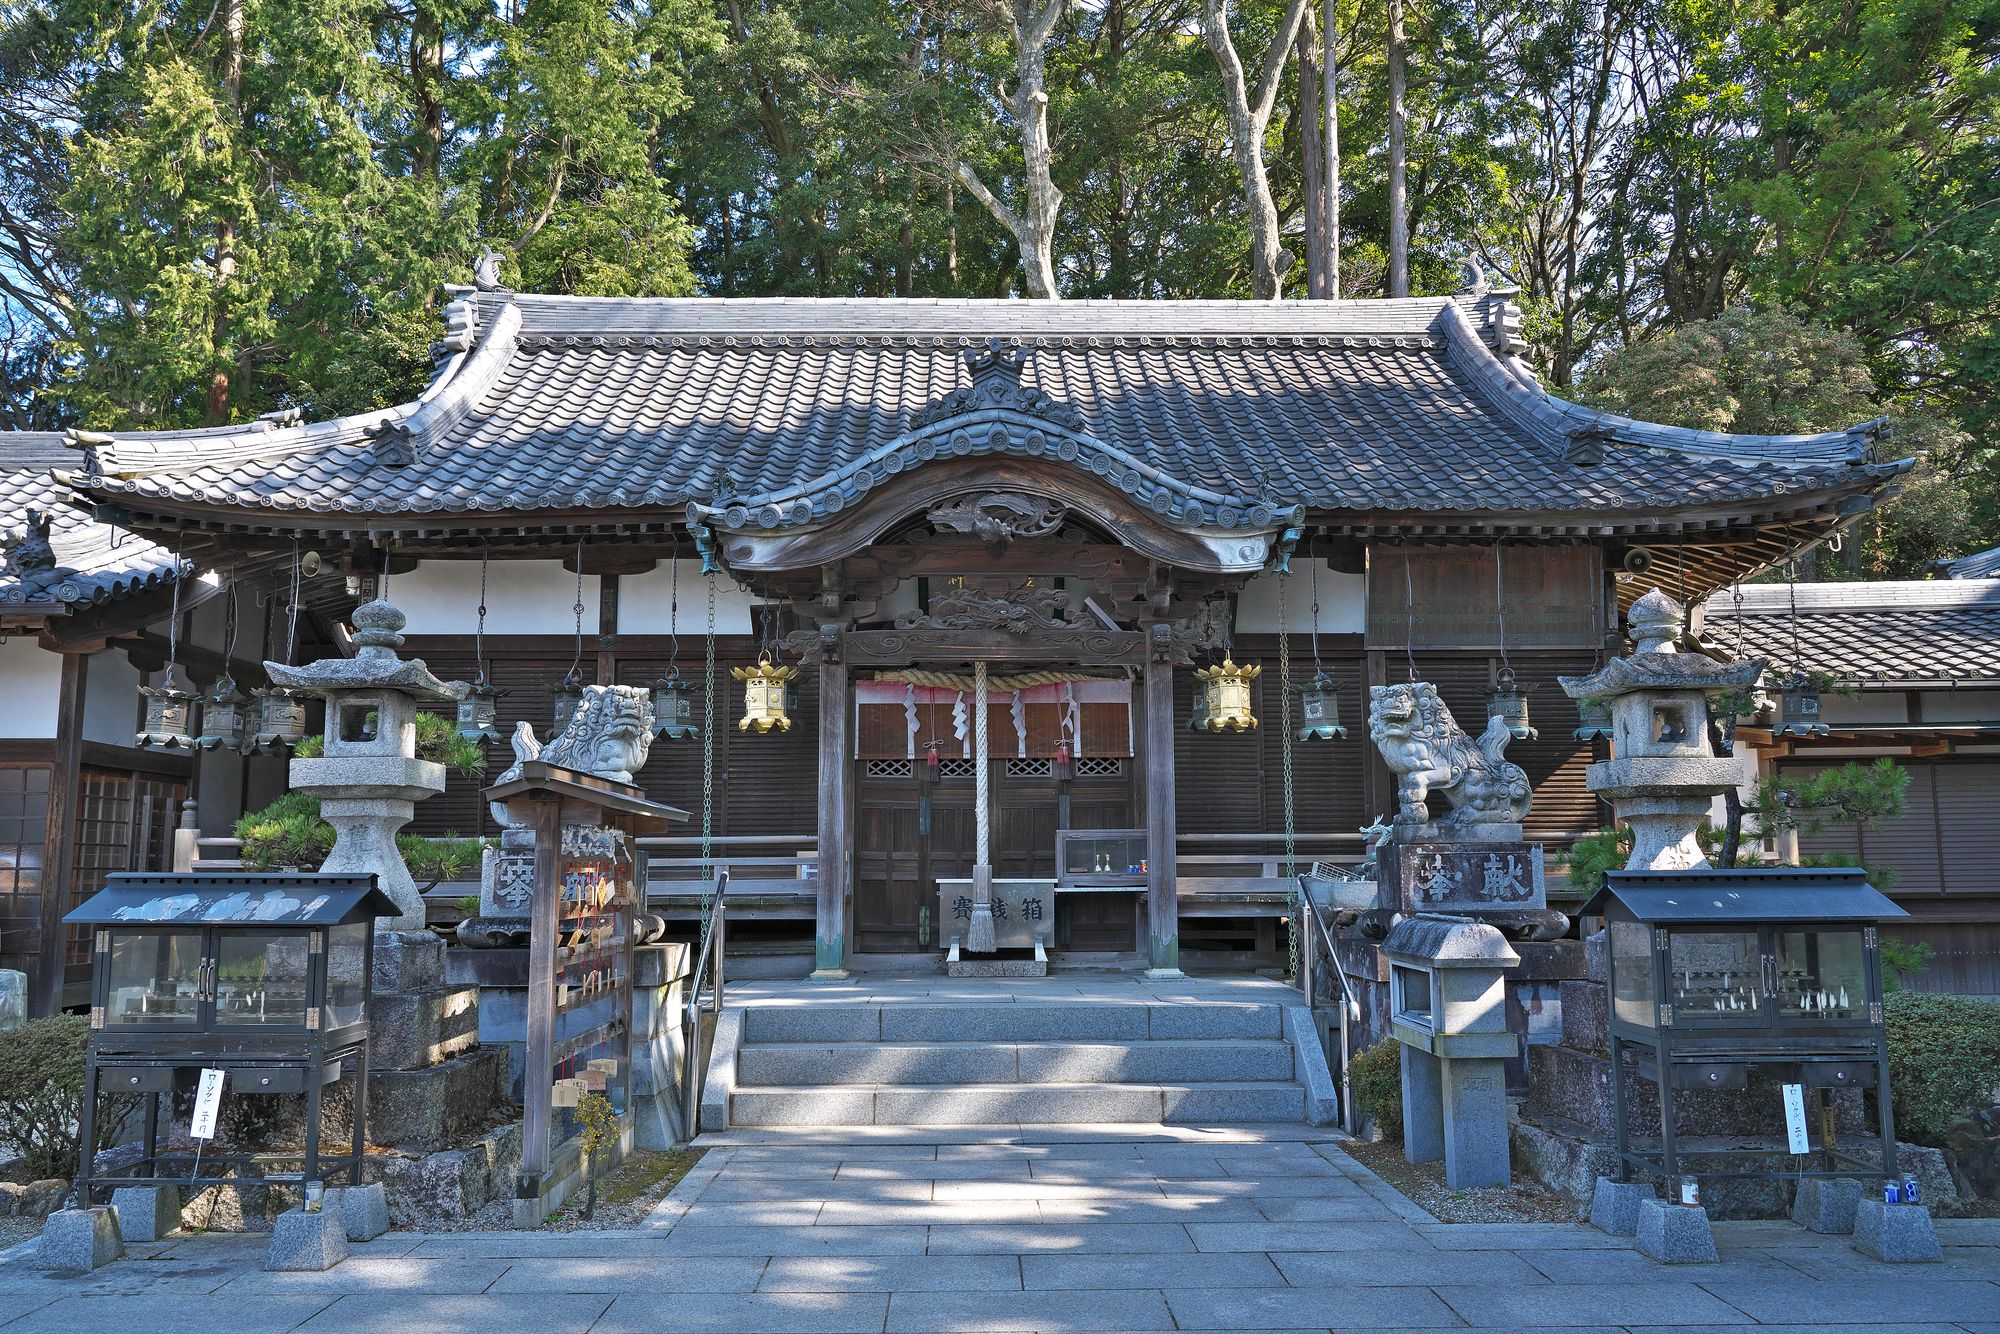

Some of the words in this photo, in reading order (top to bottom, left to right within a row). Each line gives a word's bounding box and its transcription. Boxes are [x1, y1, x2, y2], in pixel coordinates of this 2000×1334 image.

[1415, 853, 1530, 902] 奉献
[952, 895, 1043, 921] 賽銭箱
